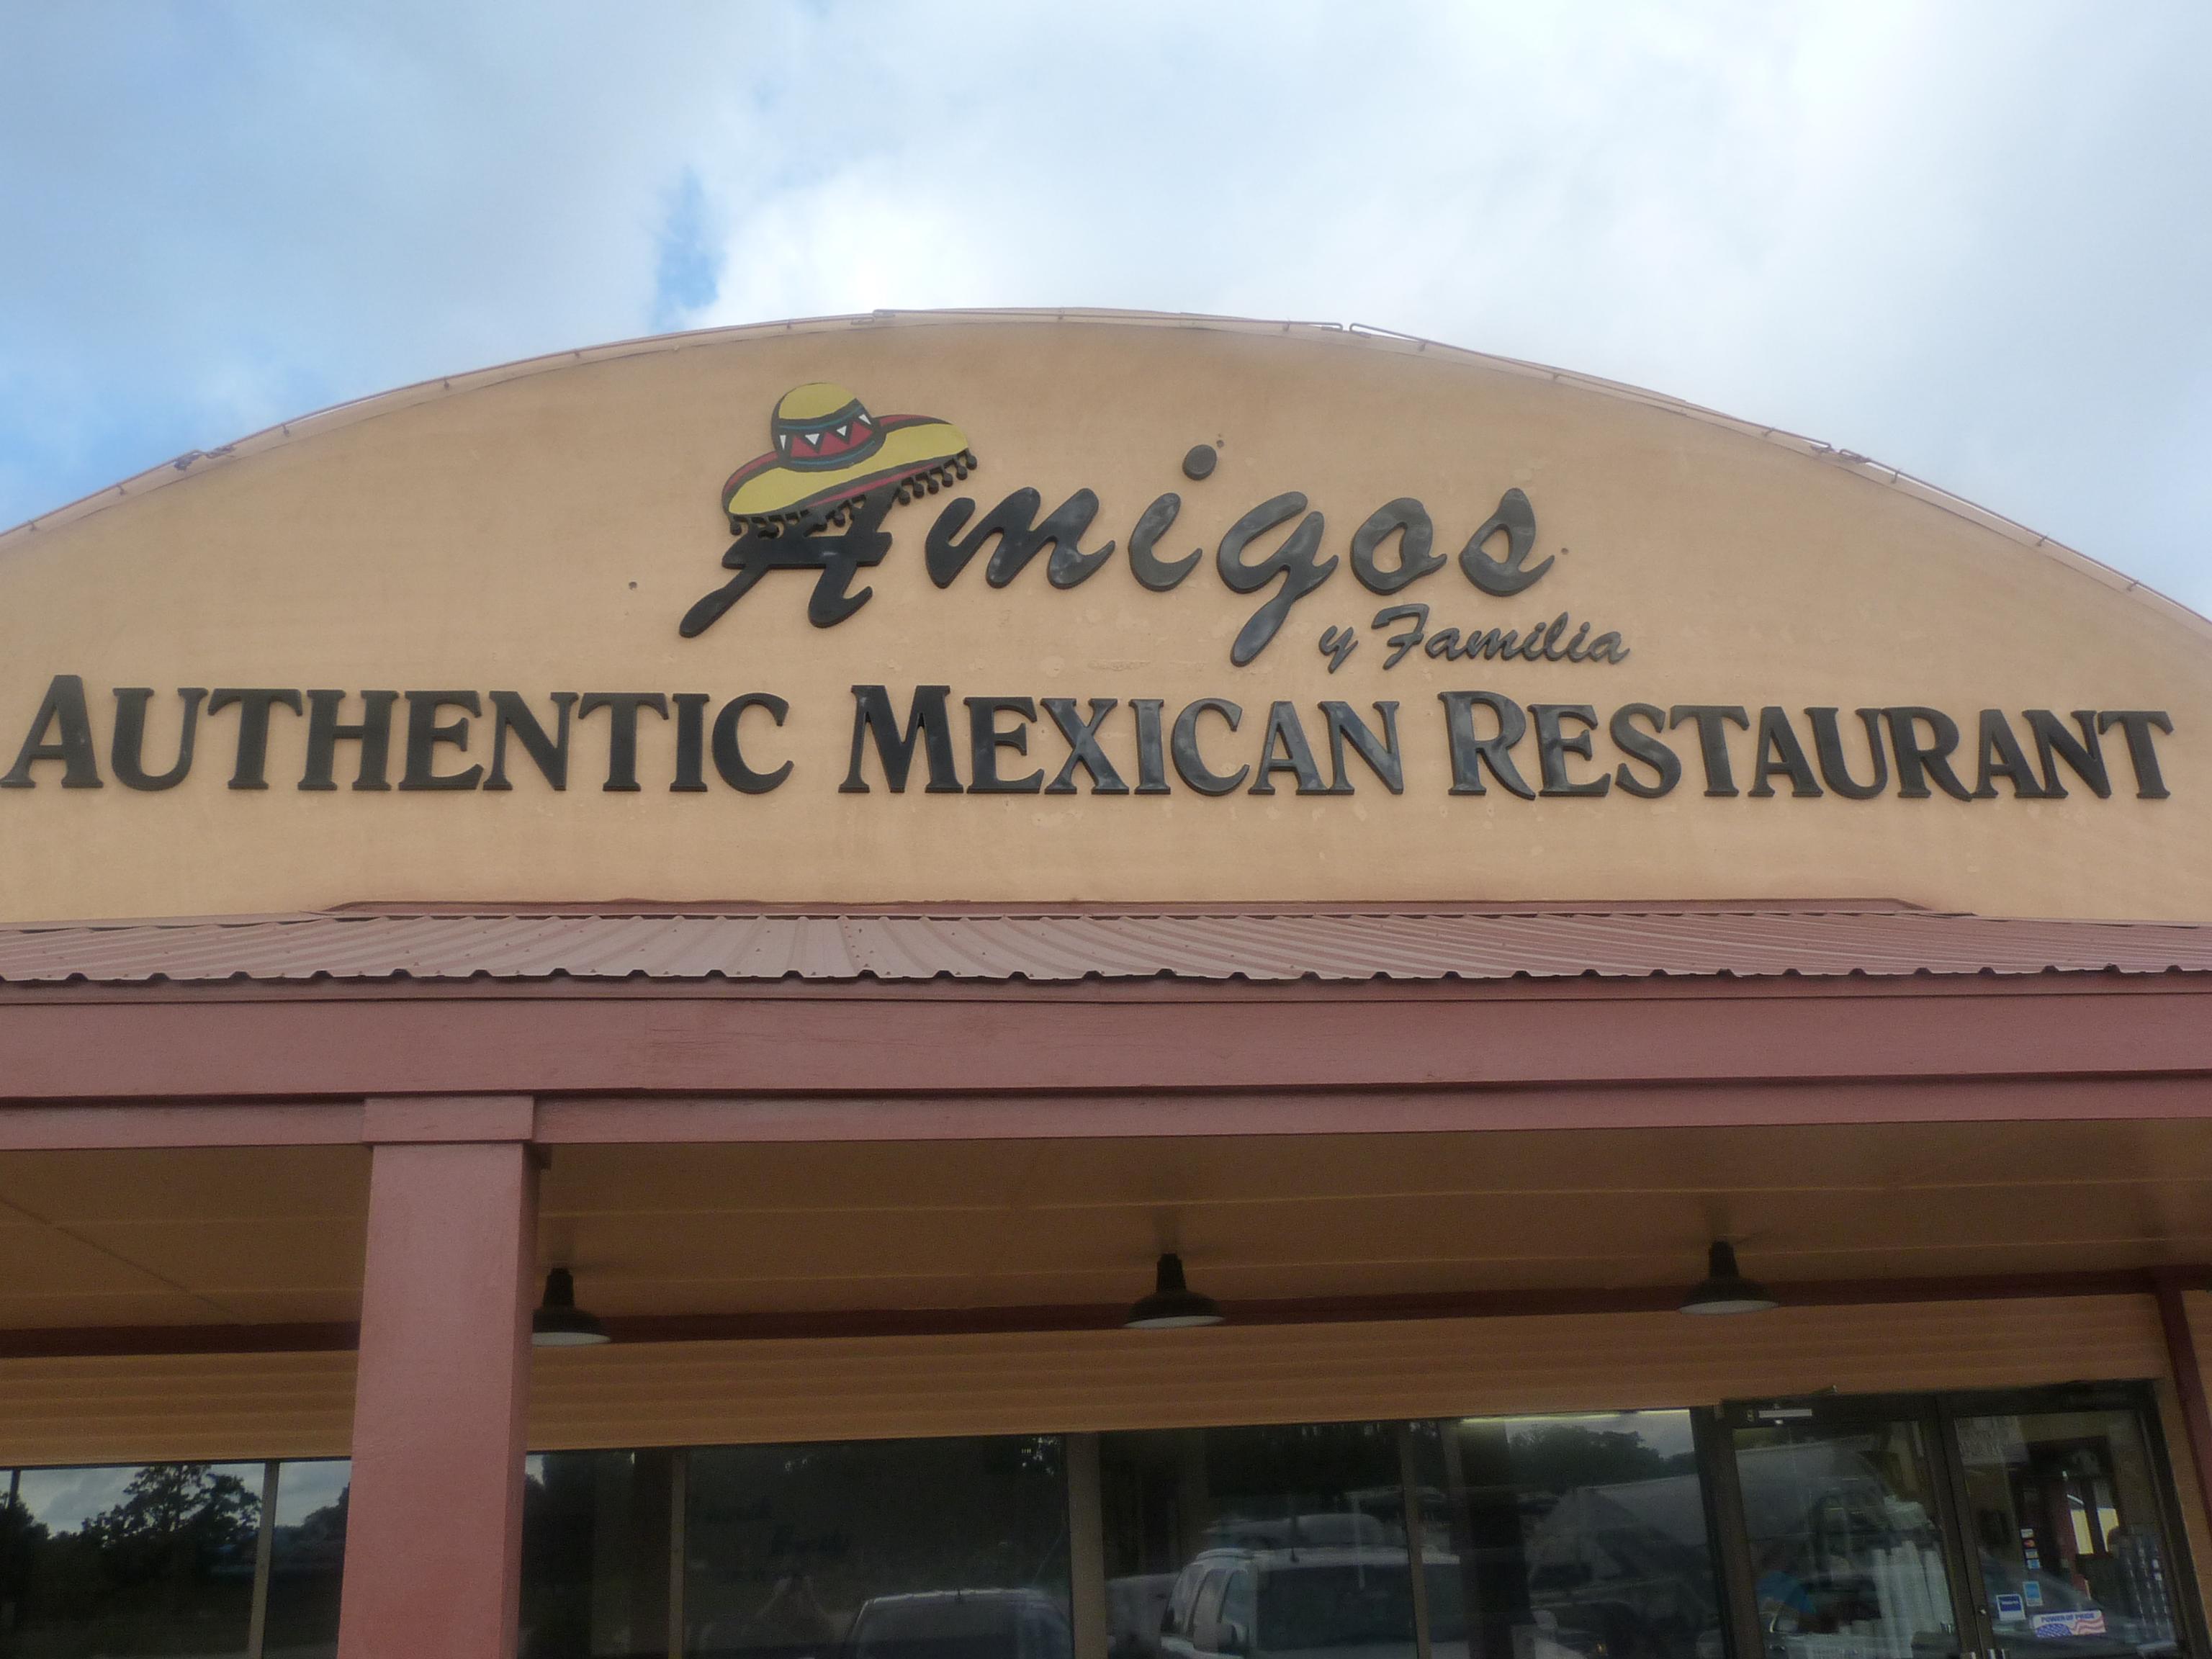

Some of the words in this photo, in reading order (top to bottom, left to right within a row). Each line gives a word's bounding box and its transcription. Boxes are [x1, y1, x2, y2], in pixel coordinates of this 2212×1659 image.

[679, 444, 1556, 667] Amigos
[1318, 624, 1359, 674] y
[1371, 603, 1631, 671] Familia
[0, 675, 795, 795] AUTHENTIC
[838, 685, 1404, 798] MEXICAN
[1437, 691, 2173, 803] RESTAURANT
